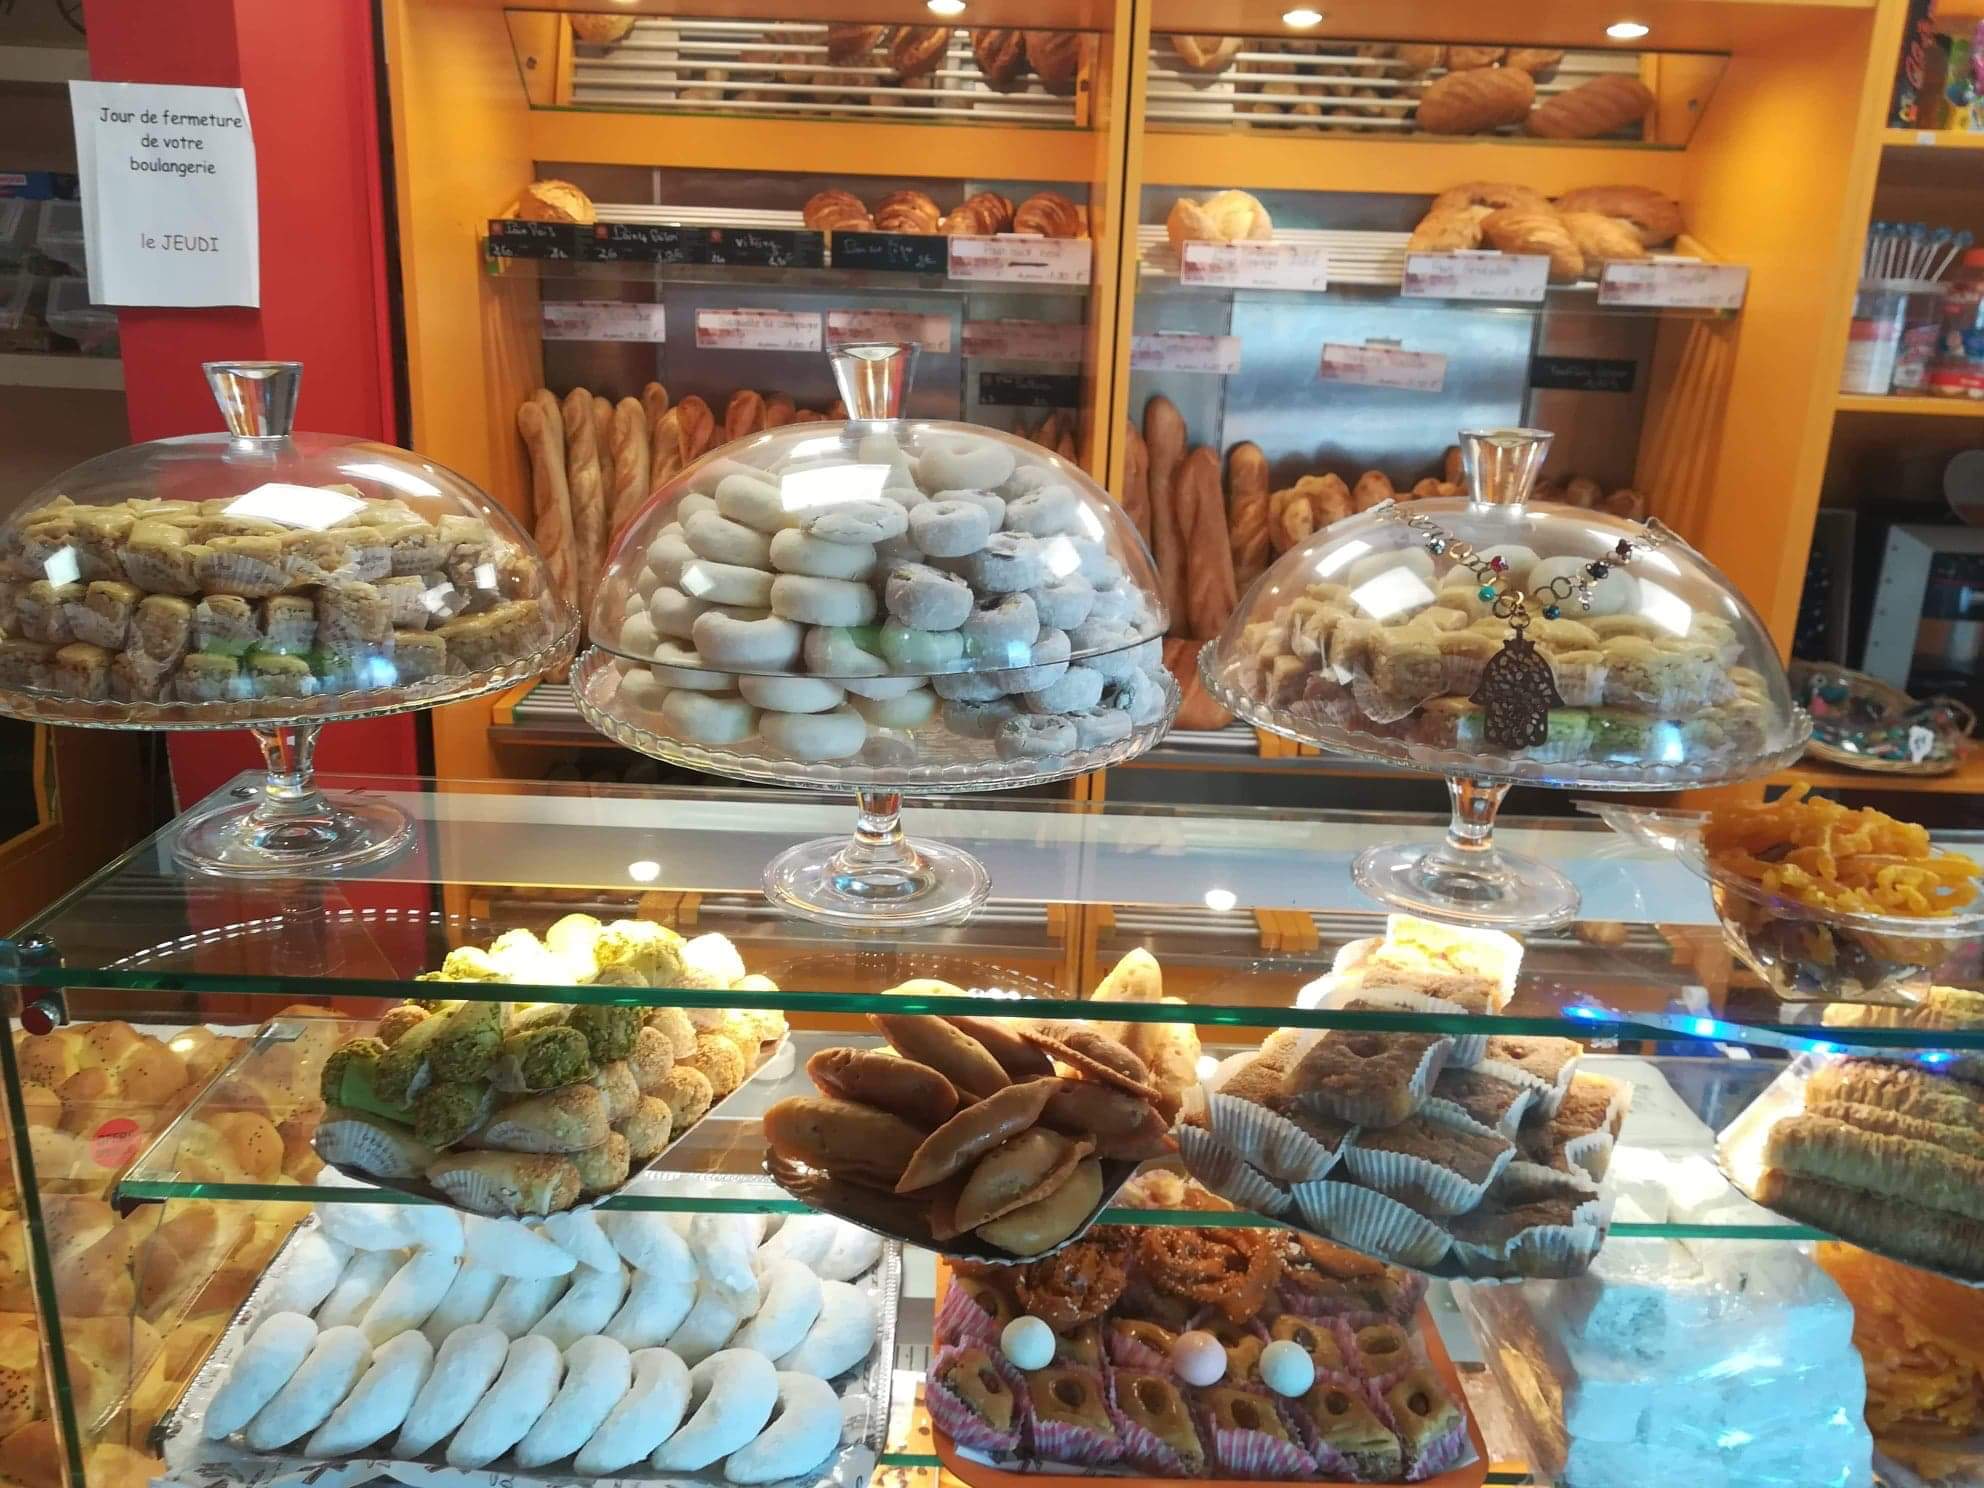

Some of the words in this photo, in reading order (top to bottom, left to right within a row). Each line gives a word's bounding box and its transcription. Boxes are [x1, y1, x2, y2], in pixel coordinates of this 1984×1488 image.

[100, 107, 135, 123] Jour
[140, 109, 158, 124] de
[163, 110, 243, 128] fermeture
[141, 134, 159, 148] de
[163, 136, 204, 150] votre
[130, 156, 216, 177] boulangerie
[140, 233, 156, 249] le
[160, 235, 219, 252] JEUDI
